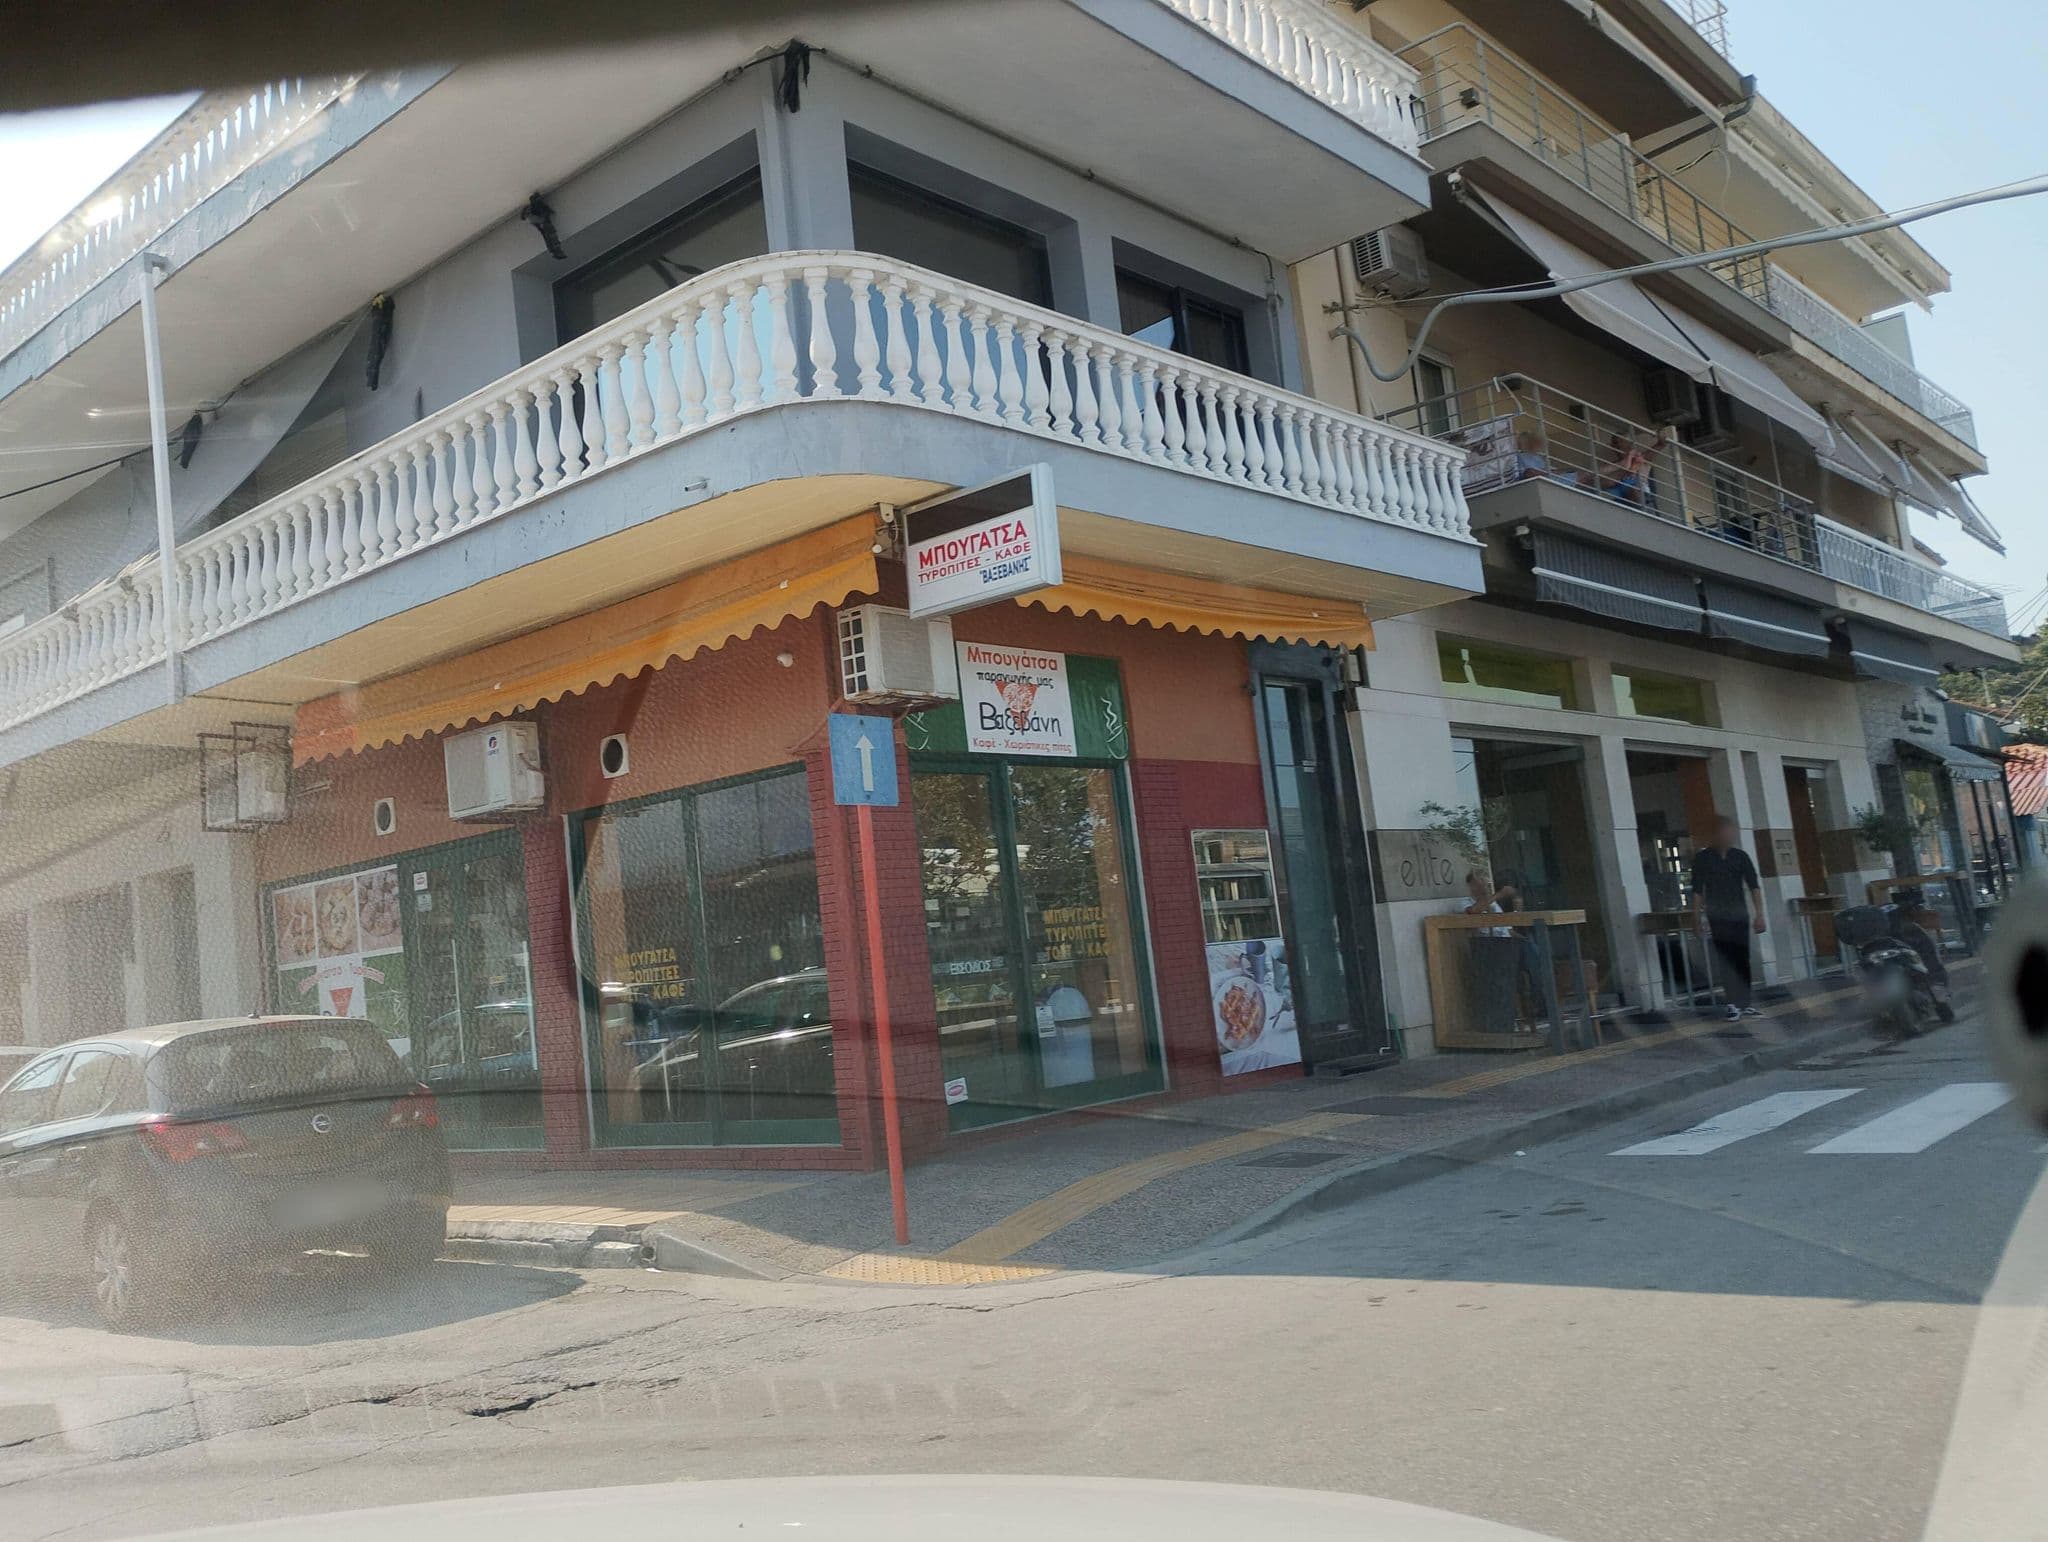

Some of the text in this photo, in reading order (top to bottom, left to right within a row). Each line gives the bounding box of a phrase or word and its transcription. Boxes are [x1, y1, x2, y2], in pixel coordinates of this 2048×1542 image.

[918, 519, 1027, 570] ΜΠΟΥΓΑΤΣΑ
[918, 556, 981, 584] ΤΥΡΟΠΙΤΕΣ
[995, 541, 1031, 561] ΚΑΦΕ
[967, 646, 1058, 671] Μπουγάτσα
[1036, 676, 1055, 690] μας
[979, 701, 1062, 737] Βαξεβάνη
[1400, 843, 1454, 888] elite
